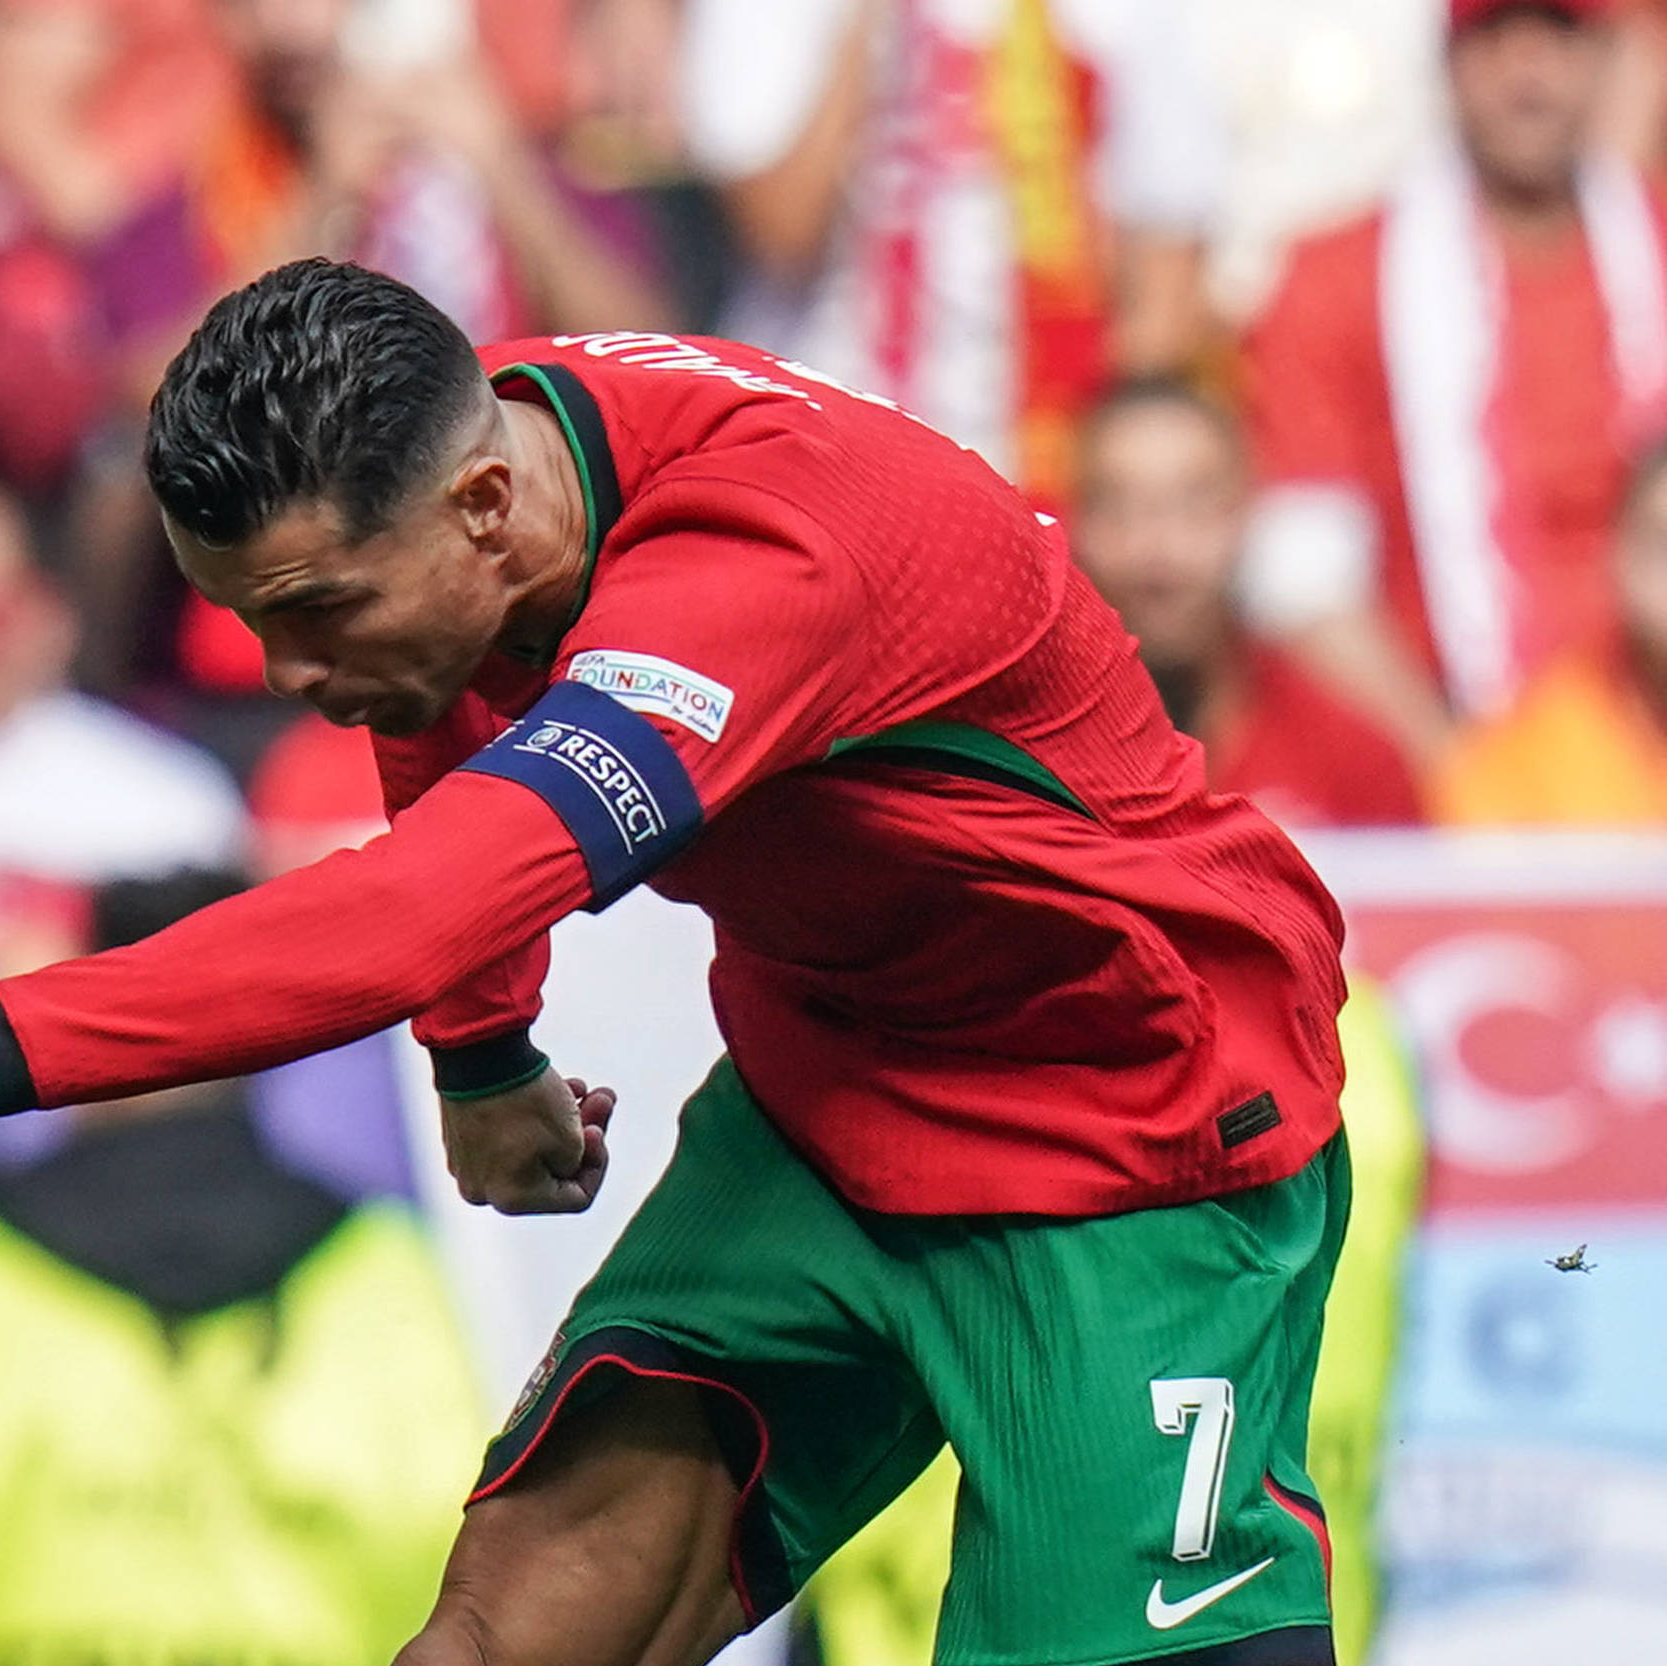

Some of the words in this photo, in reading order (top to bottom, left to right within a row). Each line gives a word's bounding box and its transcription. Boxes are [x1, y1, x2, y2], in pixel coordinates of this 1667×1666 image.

[570, 668, 725, 722] FOUNDATION
[557, 734, 659, 842] RESPECT
[1149, 1376, 1235, 1562] 7
